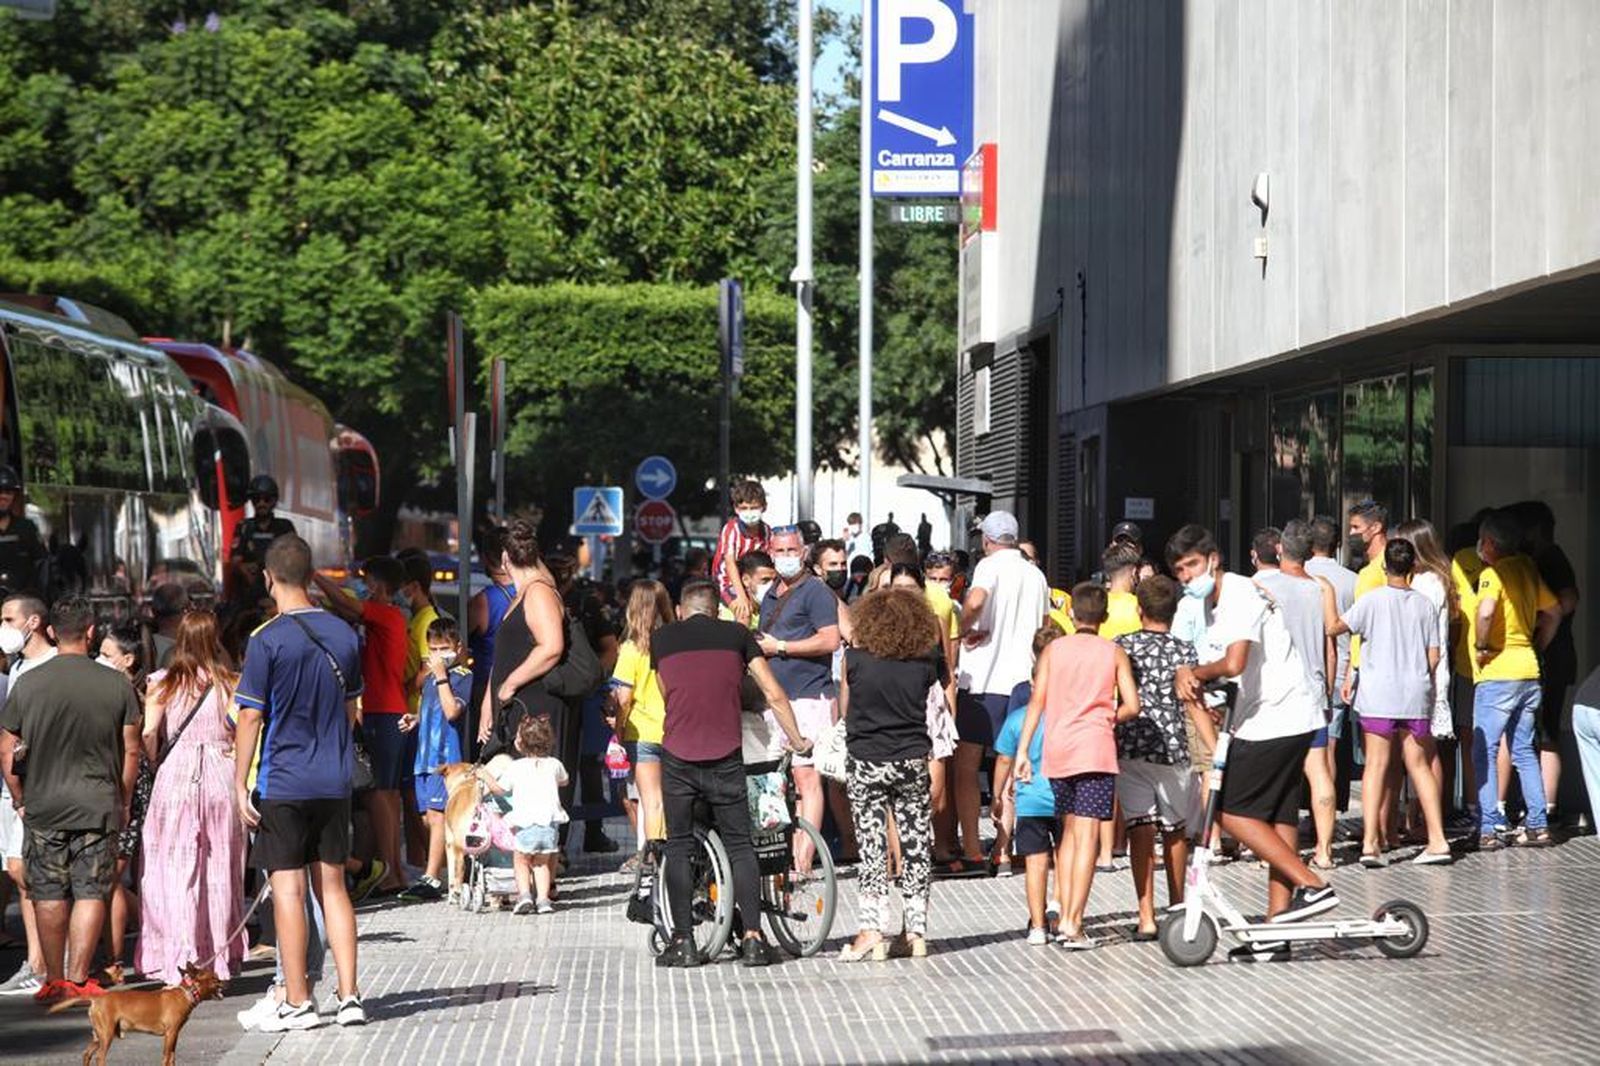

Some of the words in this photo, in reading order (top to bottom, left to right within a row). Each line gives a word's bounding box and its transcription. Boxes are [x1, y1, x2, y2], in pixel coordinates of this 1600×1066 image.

[878, 0, 958, 102] P
[878, 150, 956, 167] Carranza
[900, 206, 945, 222] LIBRE
[639, 516, 672, 527] STOP
